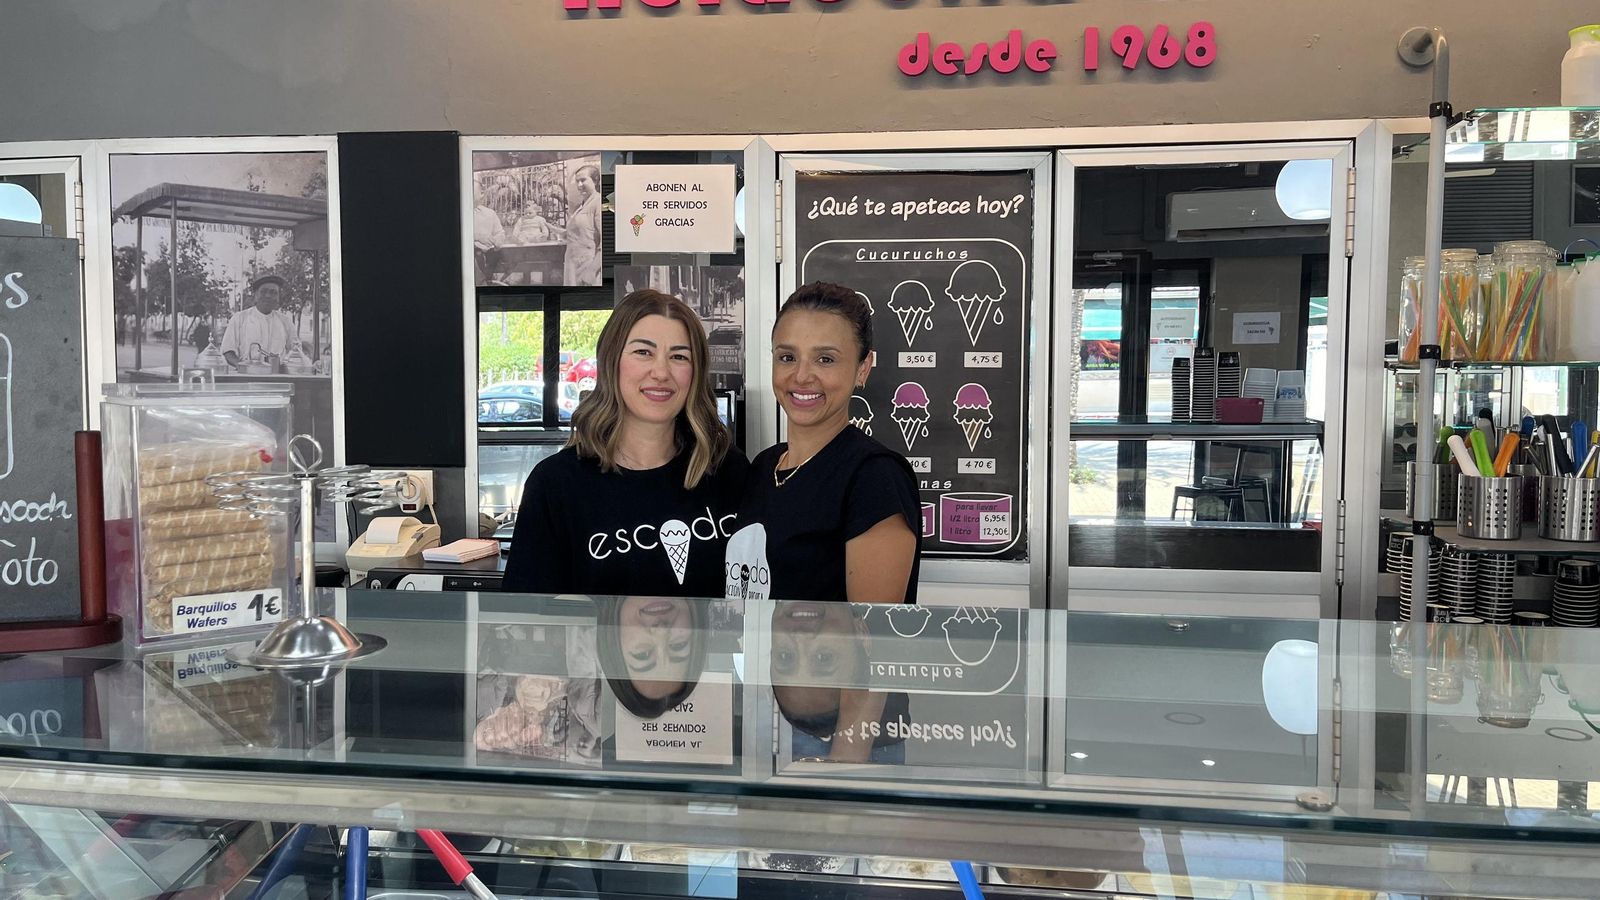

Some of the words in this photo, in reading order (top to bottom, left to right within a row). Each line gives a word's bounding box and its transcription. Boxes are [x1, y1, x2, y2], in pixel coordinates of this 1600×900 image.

[897, 29, 1057, 76] desde
[1084, 20, 1217, 72] 1968
[646, 183, 687, 192] ABONEN
[691, 183, 704, 192] AL
[642, 200, 659, 210] SER
[663, 200, 708, 210] SERVIDOS
[807, 195, 859, 220] ¿Qué
[864, 198, 886, 216] te
[890, 199, 971, 221] apetece
[976, 194, 1025, 219] hoy?
[655, 218, 695, 227] GRACIAS
[856, 246, 969, 261] Cucuruchos
[906, 355, 926, 365] 3,50
[927, 354, 934, 363] €
[971, 355, 990, 365] 4,75
[992, 354, 1000, 364] €
[922, 460, 928, 468] €
[986, 460, 993, 469] €
[920, 479, 952, 490] nas
[954, 527, 972, 535] litro
[0, 536, 59, 586] oto
[176, 600, 238, 617] Barquillos
[187, 616, 228, 629] Wafers
